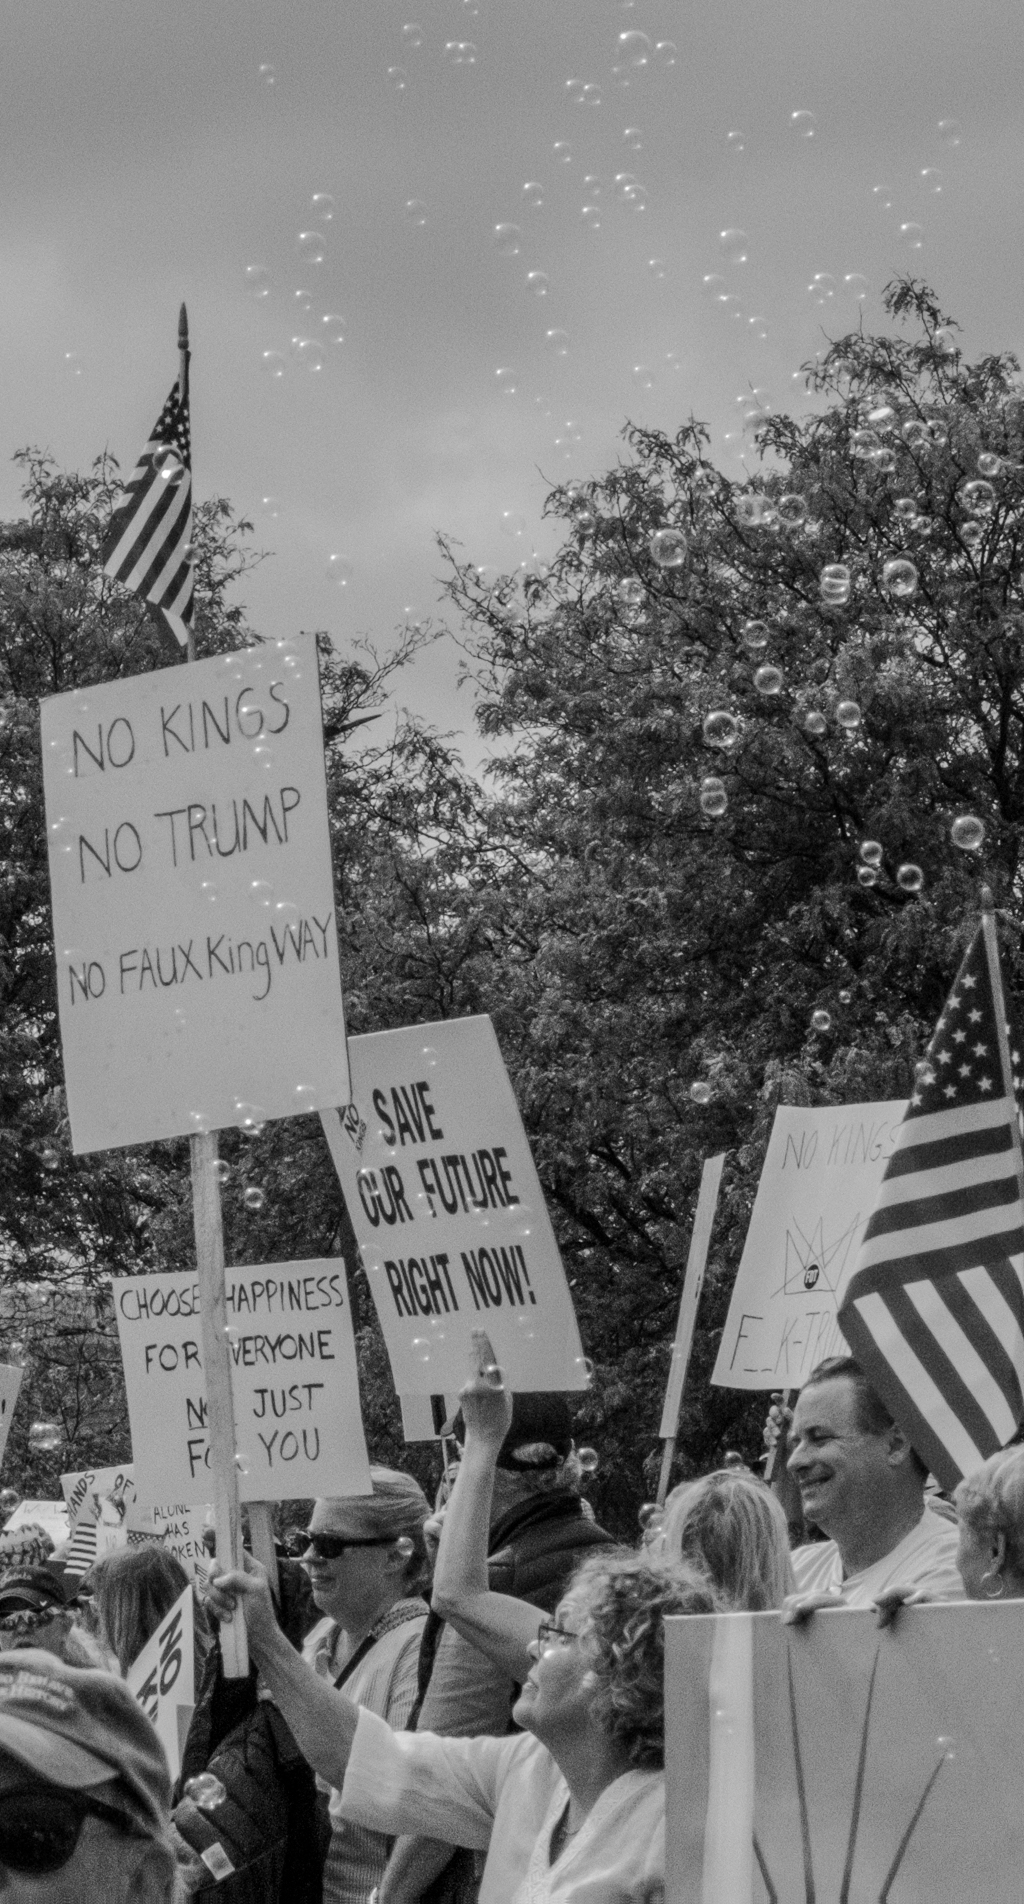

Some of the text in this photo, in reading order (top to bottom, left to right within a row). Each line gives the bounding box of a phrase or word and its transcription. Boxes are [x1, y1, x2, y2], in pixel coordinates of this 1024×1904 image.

[73, 682, 290, 778] NO KINGS
[79, 786, 301, 883] NO TRUMP
[69, 962, 106, 1005] NO
[270, 912, 332, 966] WAY
[372, 1080, 444, 1147] SAVE
[781, 1121, 903, 1170] NO KINGS
[356, 1147, 520, 1227] OUR FUTURE
[120, 1275, 343, 1321] CHOOSE HAPPINESS
[384, 1245, 537, 1317] RIGHT NOW!
[145, 1329, 335, 1374] FOR VERYONE
[253, 1383, 324, 1418] JUST
[257, 1428, 320, 1467] YOU
